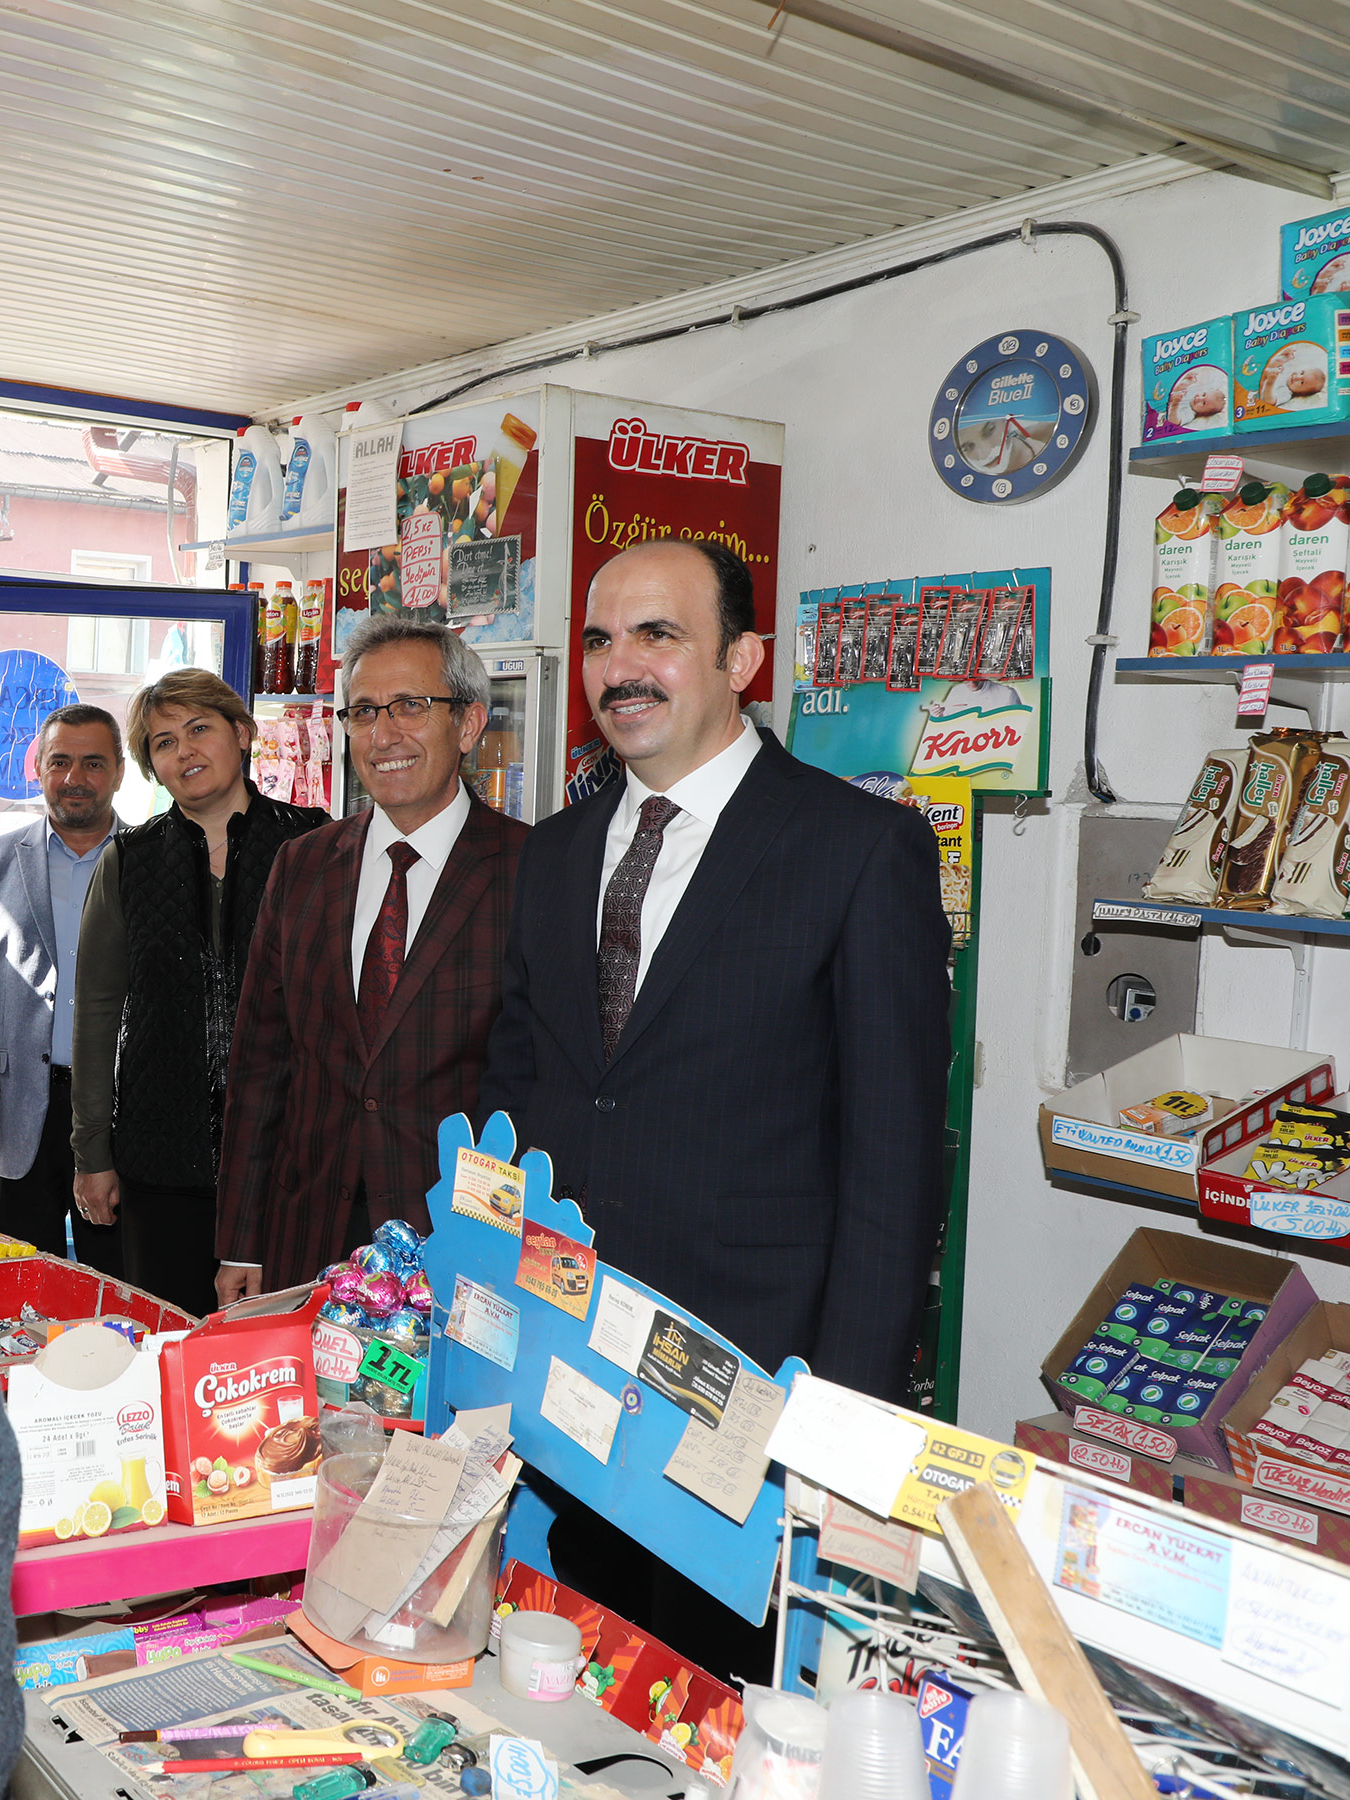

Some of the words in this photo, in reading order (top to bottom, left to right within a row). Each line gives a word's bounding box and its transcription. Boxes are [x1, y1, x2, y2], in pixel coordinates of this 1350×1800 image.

[1295, 247, 1318, 264] Baby
[1243, 301, 1306, 337] Joyce
[1244, 333, 1268, 350] Baby
[1270, 322, 1307, 342] Diapers
[1153, 328, 1208, 363] Joyce
[1154, 358, 1174, 376] Baby
[1174, 347, 1208, 367] Diapers
[991, 372, 1034, 389] Gillette
[1236, 407, 1244, 418] 3
[1145, 427, 1154, 439] 2
[355, 436, 396, 459] ALLAH
[609, 418, 749, 487] ÜLKER
[398, 436, 477, 479] LKER
[1224, 539, 1262, 551] daren
[1288, 533, 1329, 547] daren
[1159, 544, 1193, 556] daren
[1227, 553, 1256, 563] Karışık
[1161, 558, 1187, 567] Karışık
[922, 725, 1022, 762] Knorr
[1196, 766, 1224, 802] halley
[1215, 775, 1230, 795] ÜLKER
[1248, 762, 1277, 807] halley
[1272, 773, 1286, 798] ÜLKER
[1310, 761, 1341, 806] halley
[1333, 772, 1348, 797] ÜLKER
[1304, 1132, 1330, 1144] ÜLKER
[461, 1152, 498, 1172] OTOGAR
[498, 1166, 521, 1182] TAKSİ
[1287, 1156, 1319, 1168] ÜLKER
[525, 1233, 557, 1249] ceylan
[473, 1292, 493, 1311] ERCAN
[1122, 1289, 1154, 1303] Selpak
[1155, 1303, 1188, 1315] Selpak
[1174, 1330, 1212, 1344] Selpak
[1212, 1337, 1248, 1351] Selpak
[652, 1331, 690, 1366] İHSAN
[1096, 1341, 1128, 1357] Selpak
[209, 1361, 237, 1374] ÜLKER
[387, 1360, 412, 1387] TL
[1148, 1370, 1181, 1384] Selpak
[1184, 1377, 1218, 1392] Selpak
[194, 1366, 297, 1418] Çokokrem
[34, 1415, 63, 1424] AROMALI
[63, 1412, 86, 1422] İÇECEK
[122, 1409, 150, 1423] LEZZO
[119, 1421, 152, 1436] Drink
[52, 1432, 68, 1442] Adet
[116, 1434, 135, 1447] Enfes
[135, 1432, 158, 1443] Serinlik
[933, 1441, 947, 1456] 42
[1116, 1517, 1162, 1542] ERCAN
